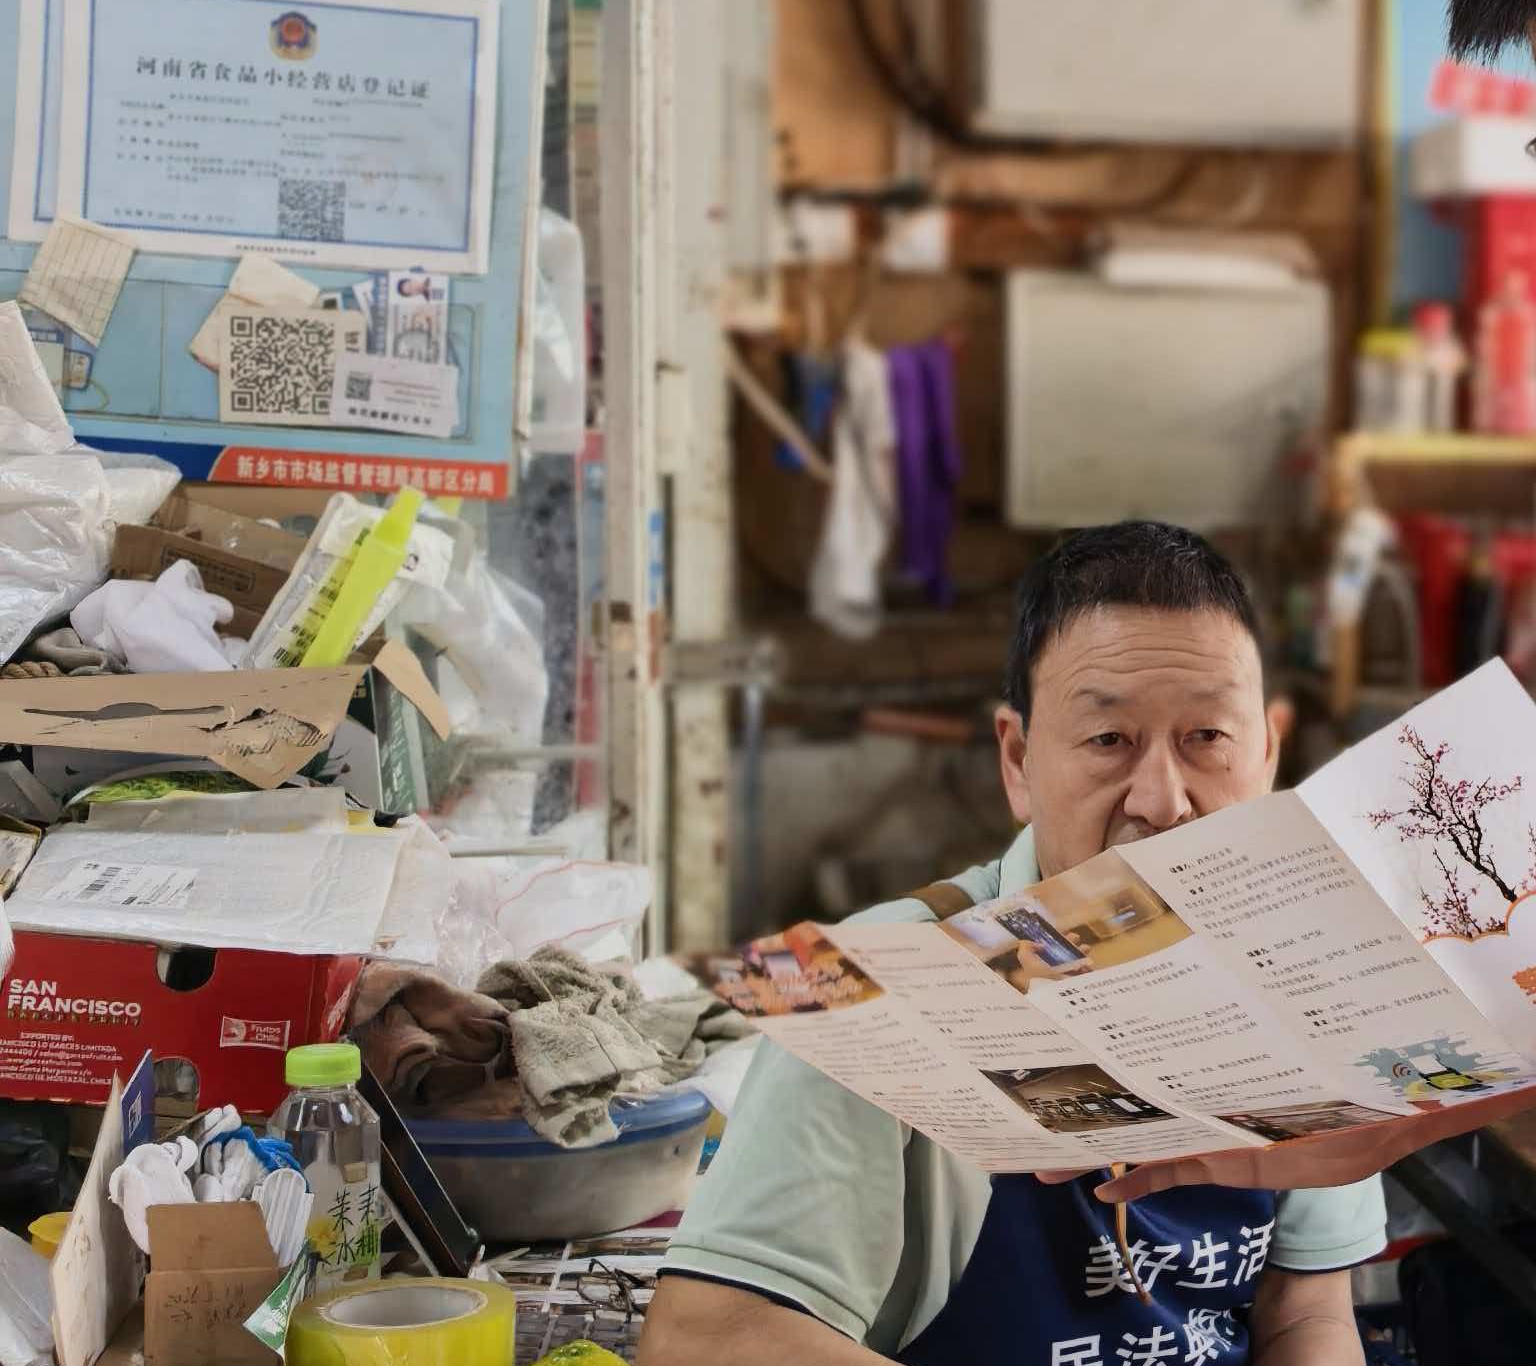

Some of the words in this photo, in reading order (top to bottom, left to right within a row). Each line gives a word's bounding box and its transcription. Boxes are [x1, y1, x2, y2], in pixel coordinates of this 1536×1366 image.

[136, 55, 431, 99] 河南省食品小经营店登记证
[9, 979, 57, 996] SAN
[8, 994, 142, 1017] FRANCISCO
[1085, 1218, 1276, 1298] 美好生活
